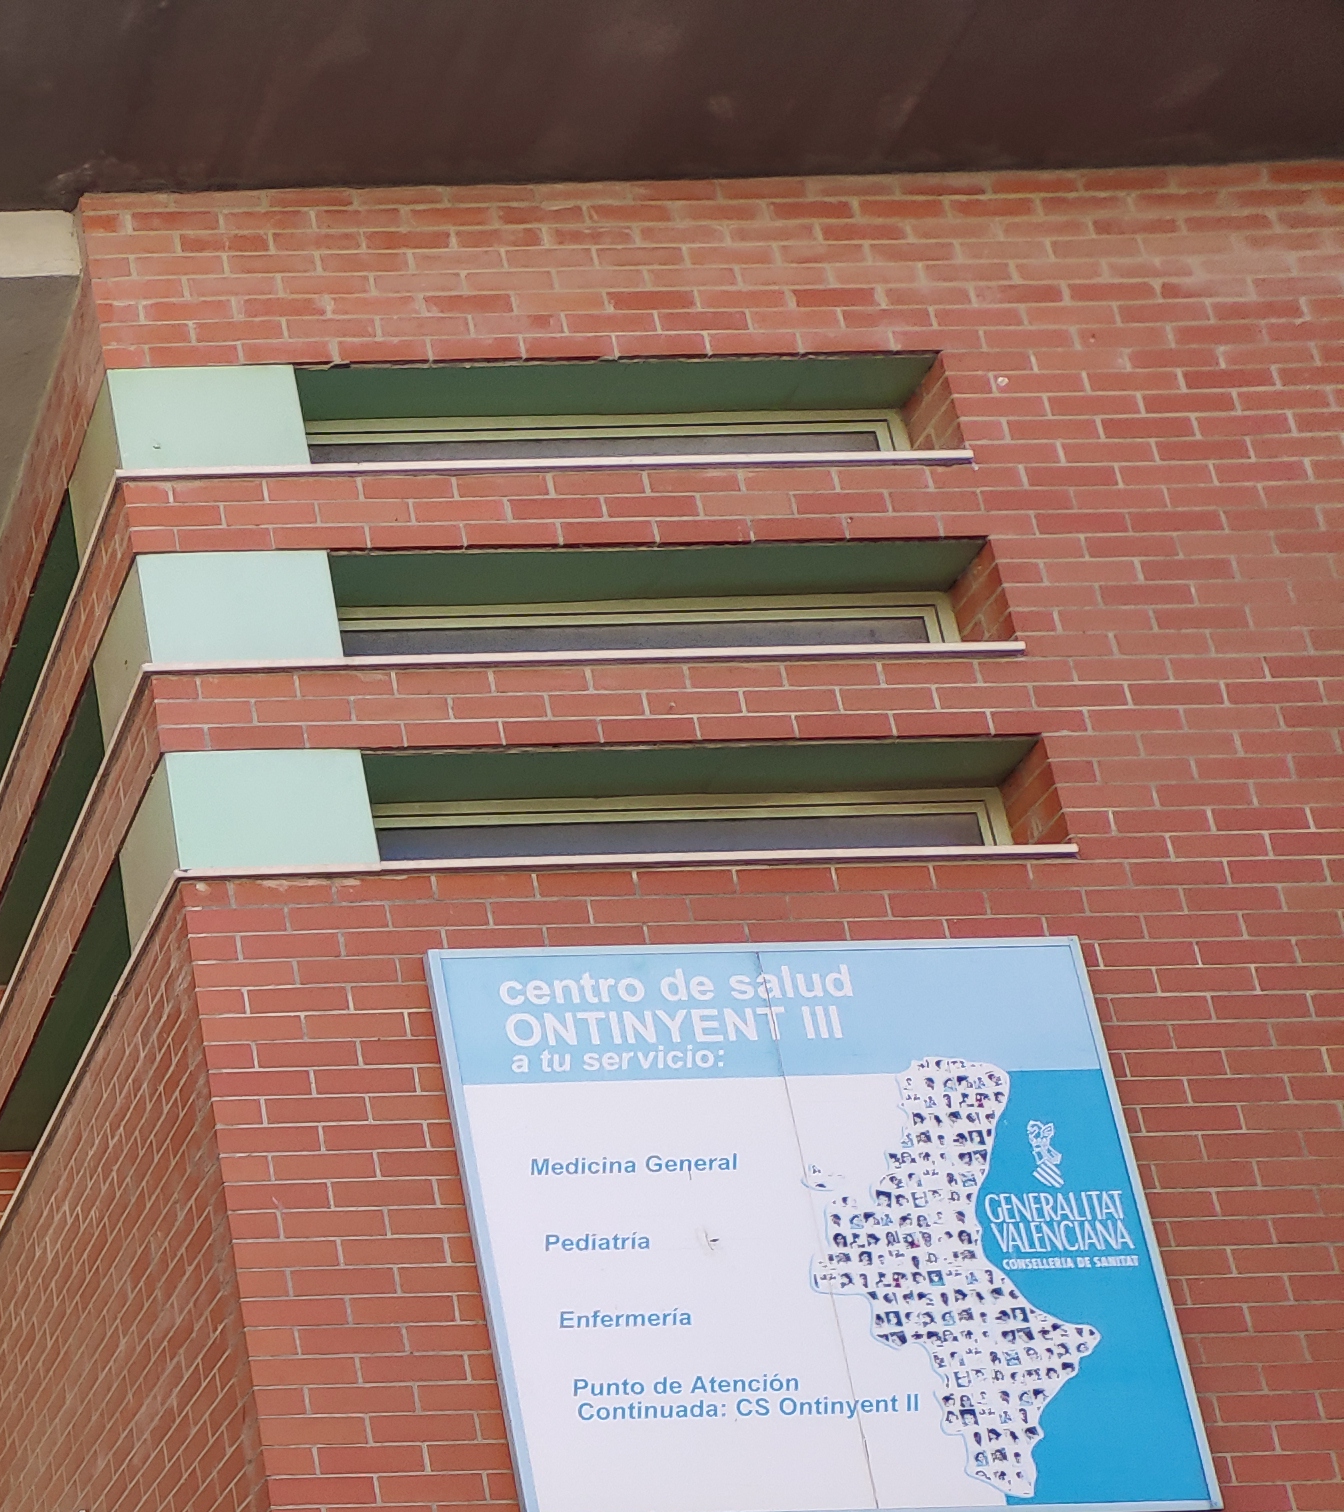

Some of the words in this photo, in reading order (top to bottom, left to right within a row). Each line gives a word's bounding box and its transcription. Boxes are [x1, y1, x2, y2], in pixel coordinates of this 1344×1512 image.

[499, 972, 645, 1005] centro
[661, 968, 714, 1001] de
[728, 964, 854, 1000] salud
[505, 1006, 785, 1046] ONTINYENT
[801, 1005, 844, 1040] III
[511, 1053, 529, 1073] a
[540, 1050, 571, 1072] tu
[582, 1044, 725, 1071] servicio:
[530, 1156, 636, 1176] Medicina
[645, 1152, 738, 1174] General
[984, 1190, 1124, 1222] GENERALITAT
[545, 1231, 650, 1252] Pediatría
[990, 1220, 1135, 1253] VALENCIANA
[1002, 1256, 1074, 1270] CONSELLERIA
[1076, 1256, 1091, 1268] DE
[1093, 1255, 1139, 1267] SANITAT
[559, 1308, 692, 1329] Enfermería
[572, 1378, 645, 1397] Punto
[653, 1377, 683, 1395] de
[690, 1373, 799, 1394] Atención
[577, 1400, 726, 1421] Continuada:
[735, 1397, 770, 1417] CS
[778, 1395, 899, 1419] Ontinyent
[906, 1393, 919, 1412] II
